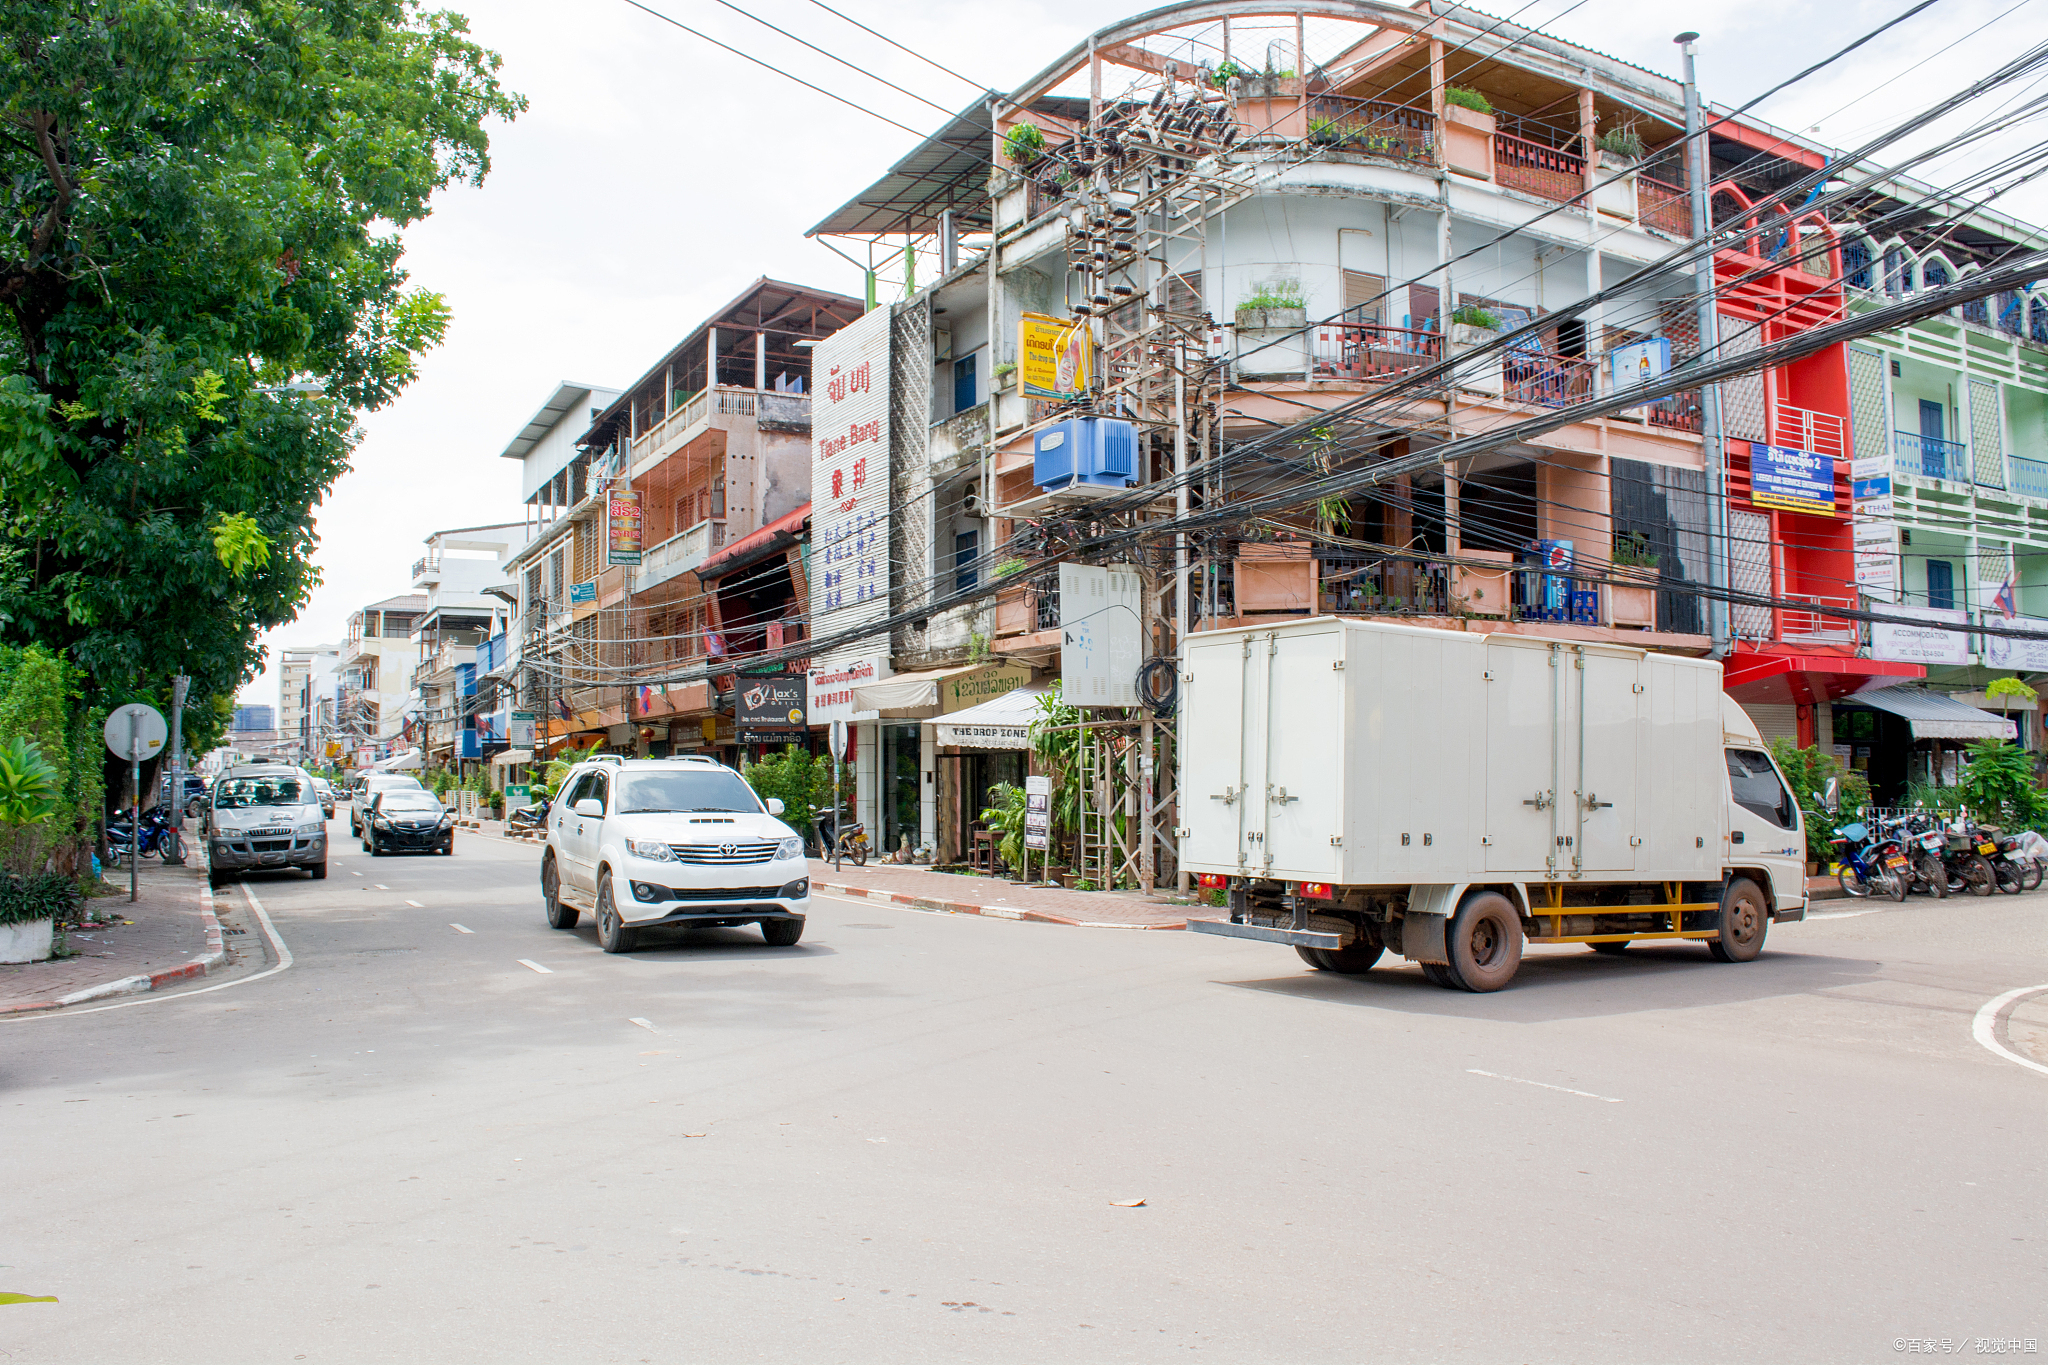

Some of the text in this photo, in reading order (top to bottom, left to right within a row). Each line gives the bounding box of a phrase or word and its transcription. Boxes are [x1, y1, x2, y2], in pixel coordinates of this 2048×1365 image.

[850, 420, 879, 446] Bang
[1814, 457, 1821, 470] 2
[1868, 503, 1890, 513] THAI
[1893, 629, 1949, 640] ACCOMMODATION
[953, 727, 1027, 738] THE DROP ZONE
